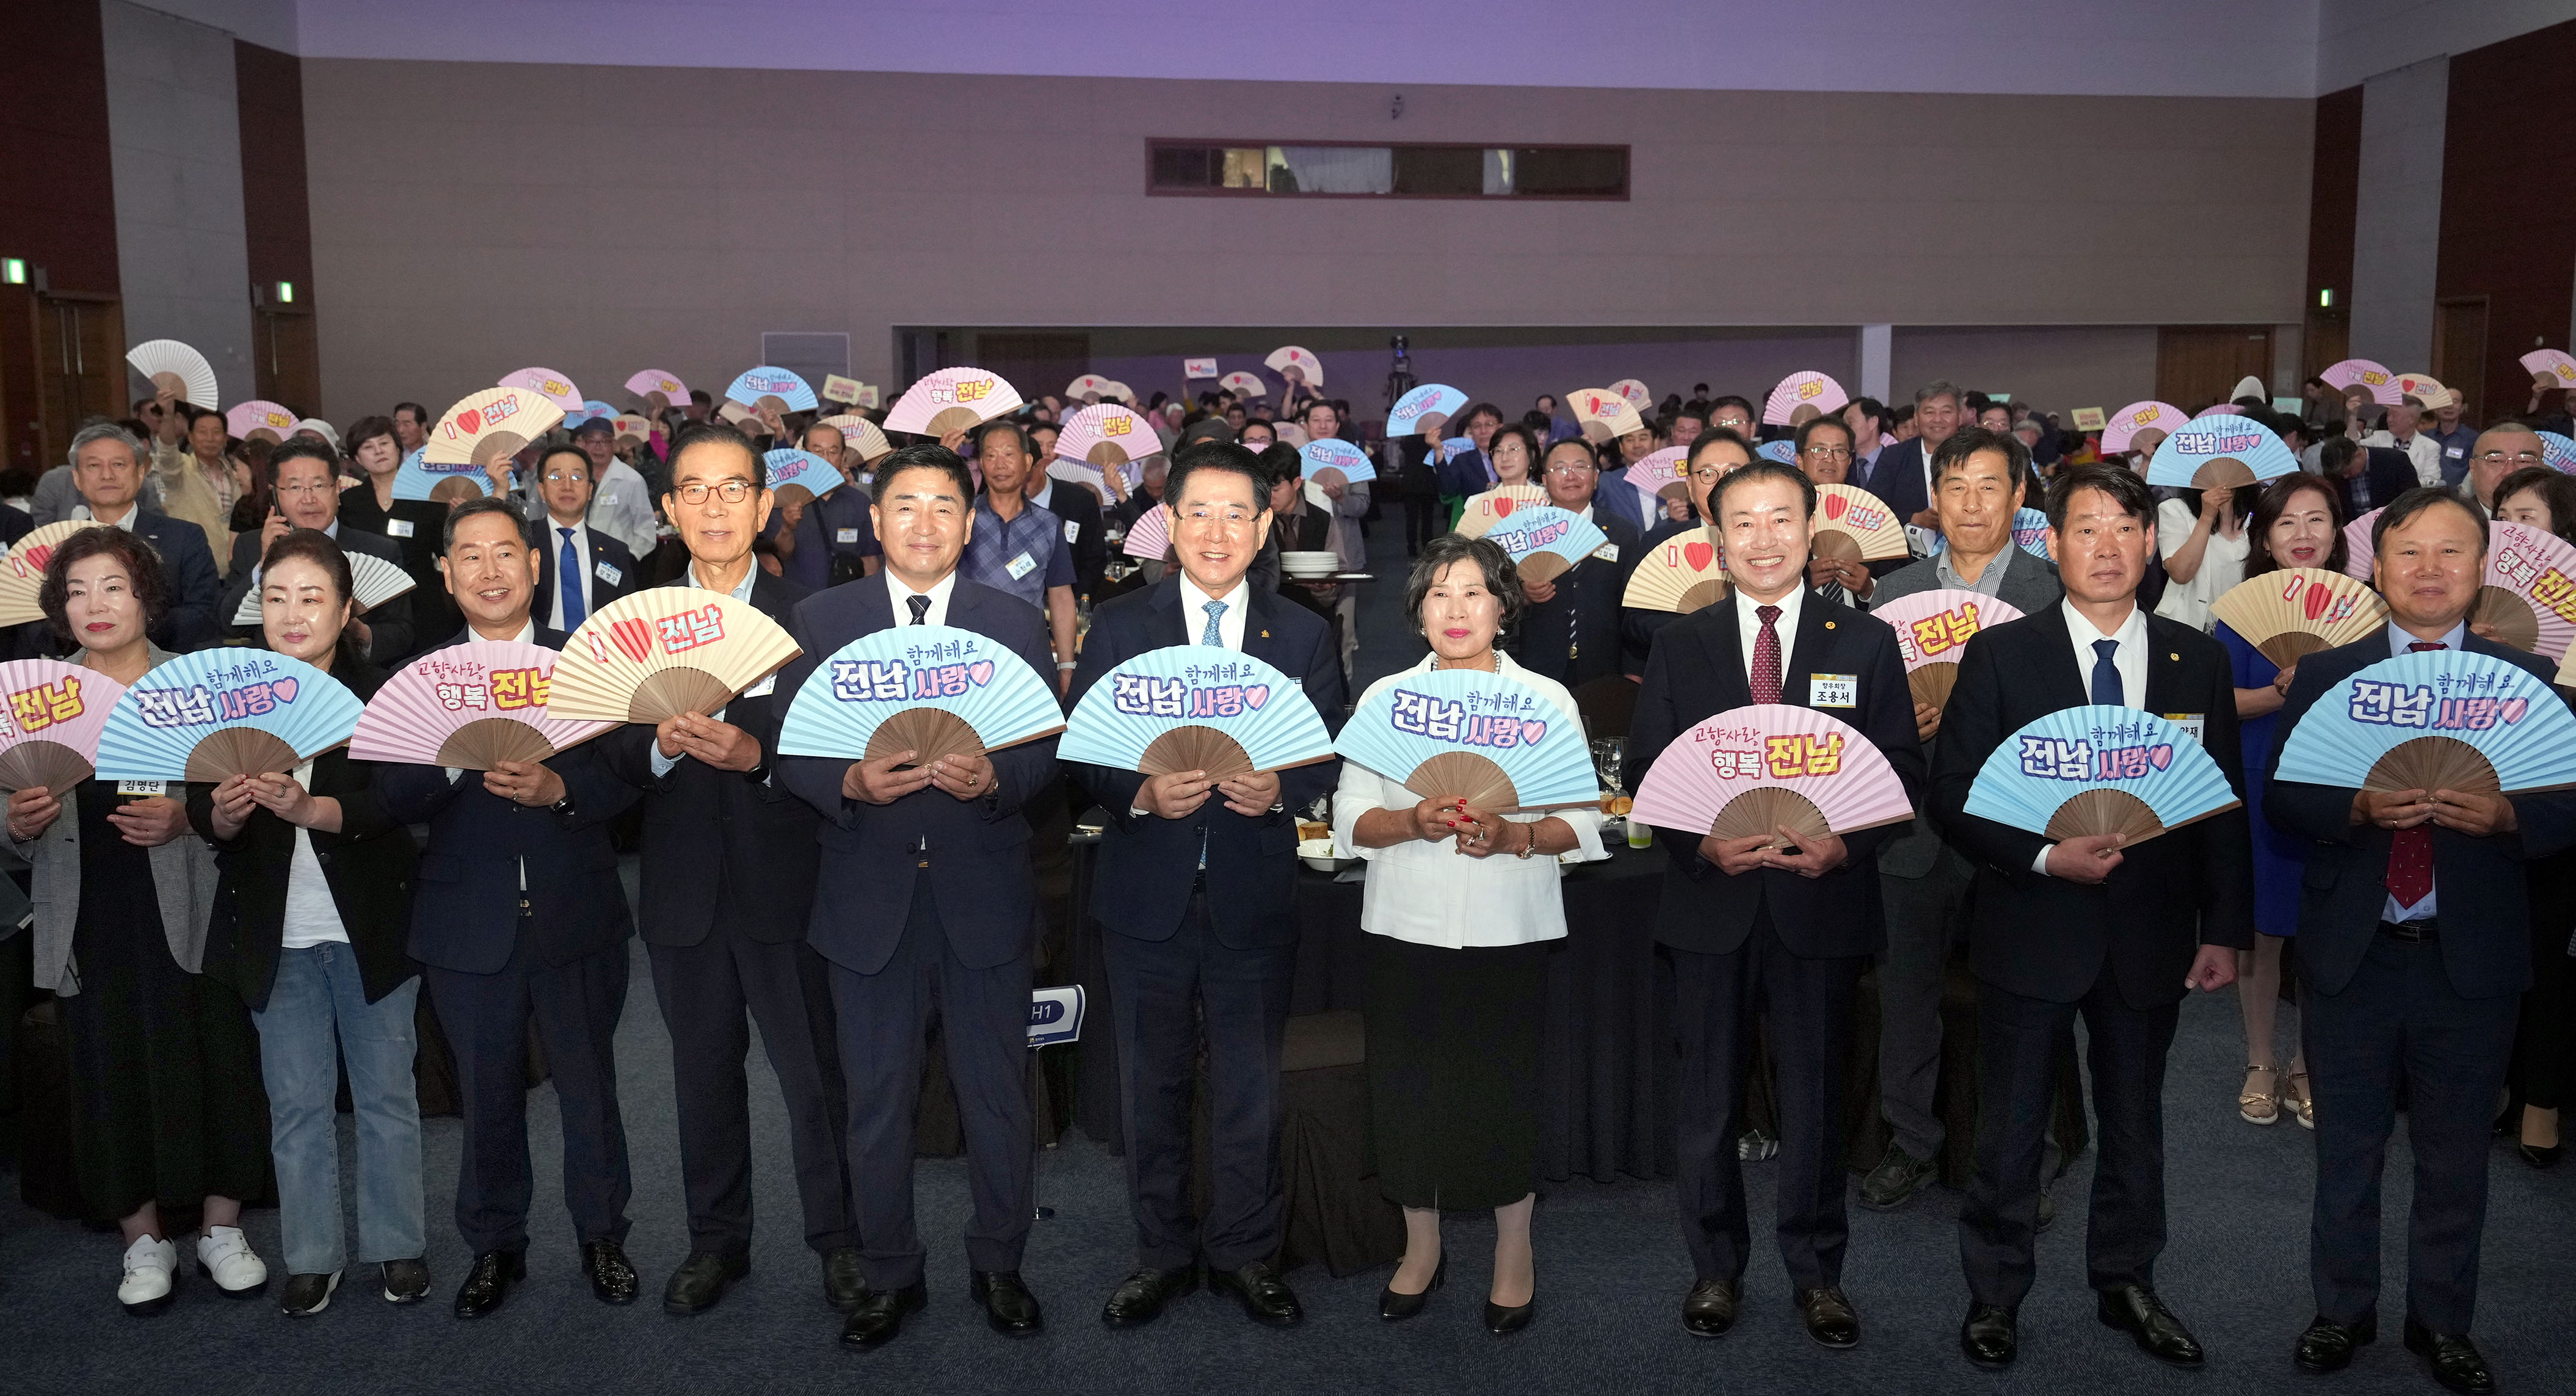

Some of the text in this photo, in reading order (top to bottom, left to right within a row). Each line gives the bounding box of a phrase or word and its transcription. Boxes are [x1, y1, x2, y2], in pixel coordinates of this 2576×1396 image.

[544, 379, 571, 397] 전남
[746, 375, 769, 392] 전남
[1799, 378, 1823, 400] 전남
[2364, 371, 2388, 386] 전남
[931, 378, 994, 403] 행복 전남
[267, 412, 291, 428] 전남
[445, 394, 520, 439] I 전남
[1395, 403, 1420, 420] 전남
[1599, 402, 1622, 417] 전남
[2133, 405, 2160, 426] 전남
[1103, 415, 1132, 437] 전남
[1309, 444, 1333, 463] 전남
[2175, 433, 2249, 454] 전남 사랑
[777, 463, 800, 482] 사랑
[1674, 459, 1688, 477] 전
[1483, 499, 1490, 516] I
[1846, 504, 1885, 531] 전남
[1523, 512, 1558, 531] 함께해요
[2009, 516, 2044, 527] 께해요
[1531, 524, 1558, 549] 사랑
[2502, 526, 2551, 567] 고향사랑
[12, 557, 27, 577] I
[1669, 546, 1677, 568] I
[2494, 548, 2538, 588] 행복
[2283, 575, 2304, 601] I
[588, 603, 725, 663] I 전남
[1911, 601, 1981, 657] 전남
[907, 640, 978, 664] 함께해요
[206, 659, 278, 689] 함께해요
[419, 660, 485, 682] 고향사랑
[830, 659, 970, 701] 전남 사랑
[1185, 662, 1255, 684] 함께해요
[436, 682, 487, 711] 행복
[1114, 673, 1246, 718] 전남 사랑
[2436, 673, 2516, 698] 함께해요
[8, 674, 84, 734] 전남
[134, 680, 276, 728] 전남 사랑
[1467, 691, 1535, 712] 함께해요
[1816, 691, 1849, 704] 조용서
[2349, 679, 2500, 731] 전남 사랑
[1391, 689, 1522, 748] 전남 사랑
[1694, 726, 1761, 747] 고향사랑
[2091, 722, 2158, 747] 함께해요
[1712, 732, 1845, 780] 행복 전남
[2019, 735, 2149, 783] 전남 사랑
[125, 780, 160, 792] 김명단
